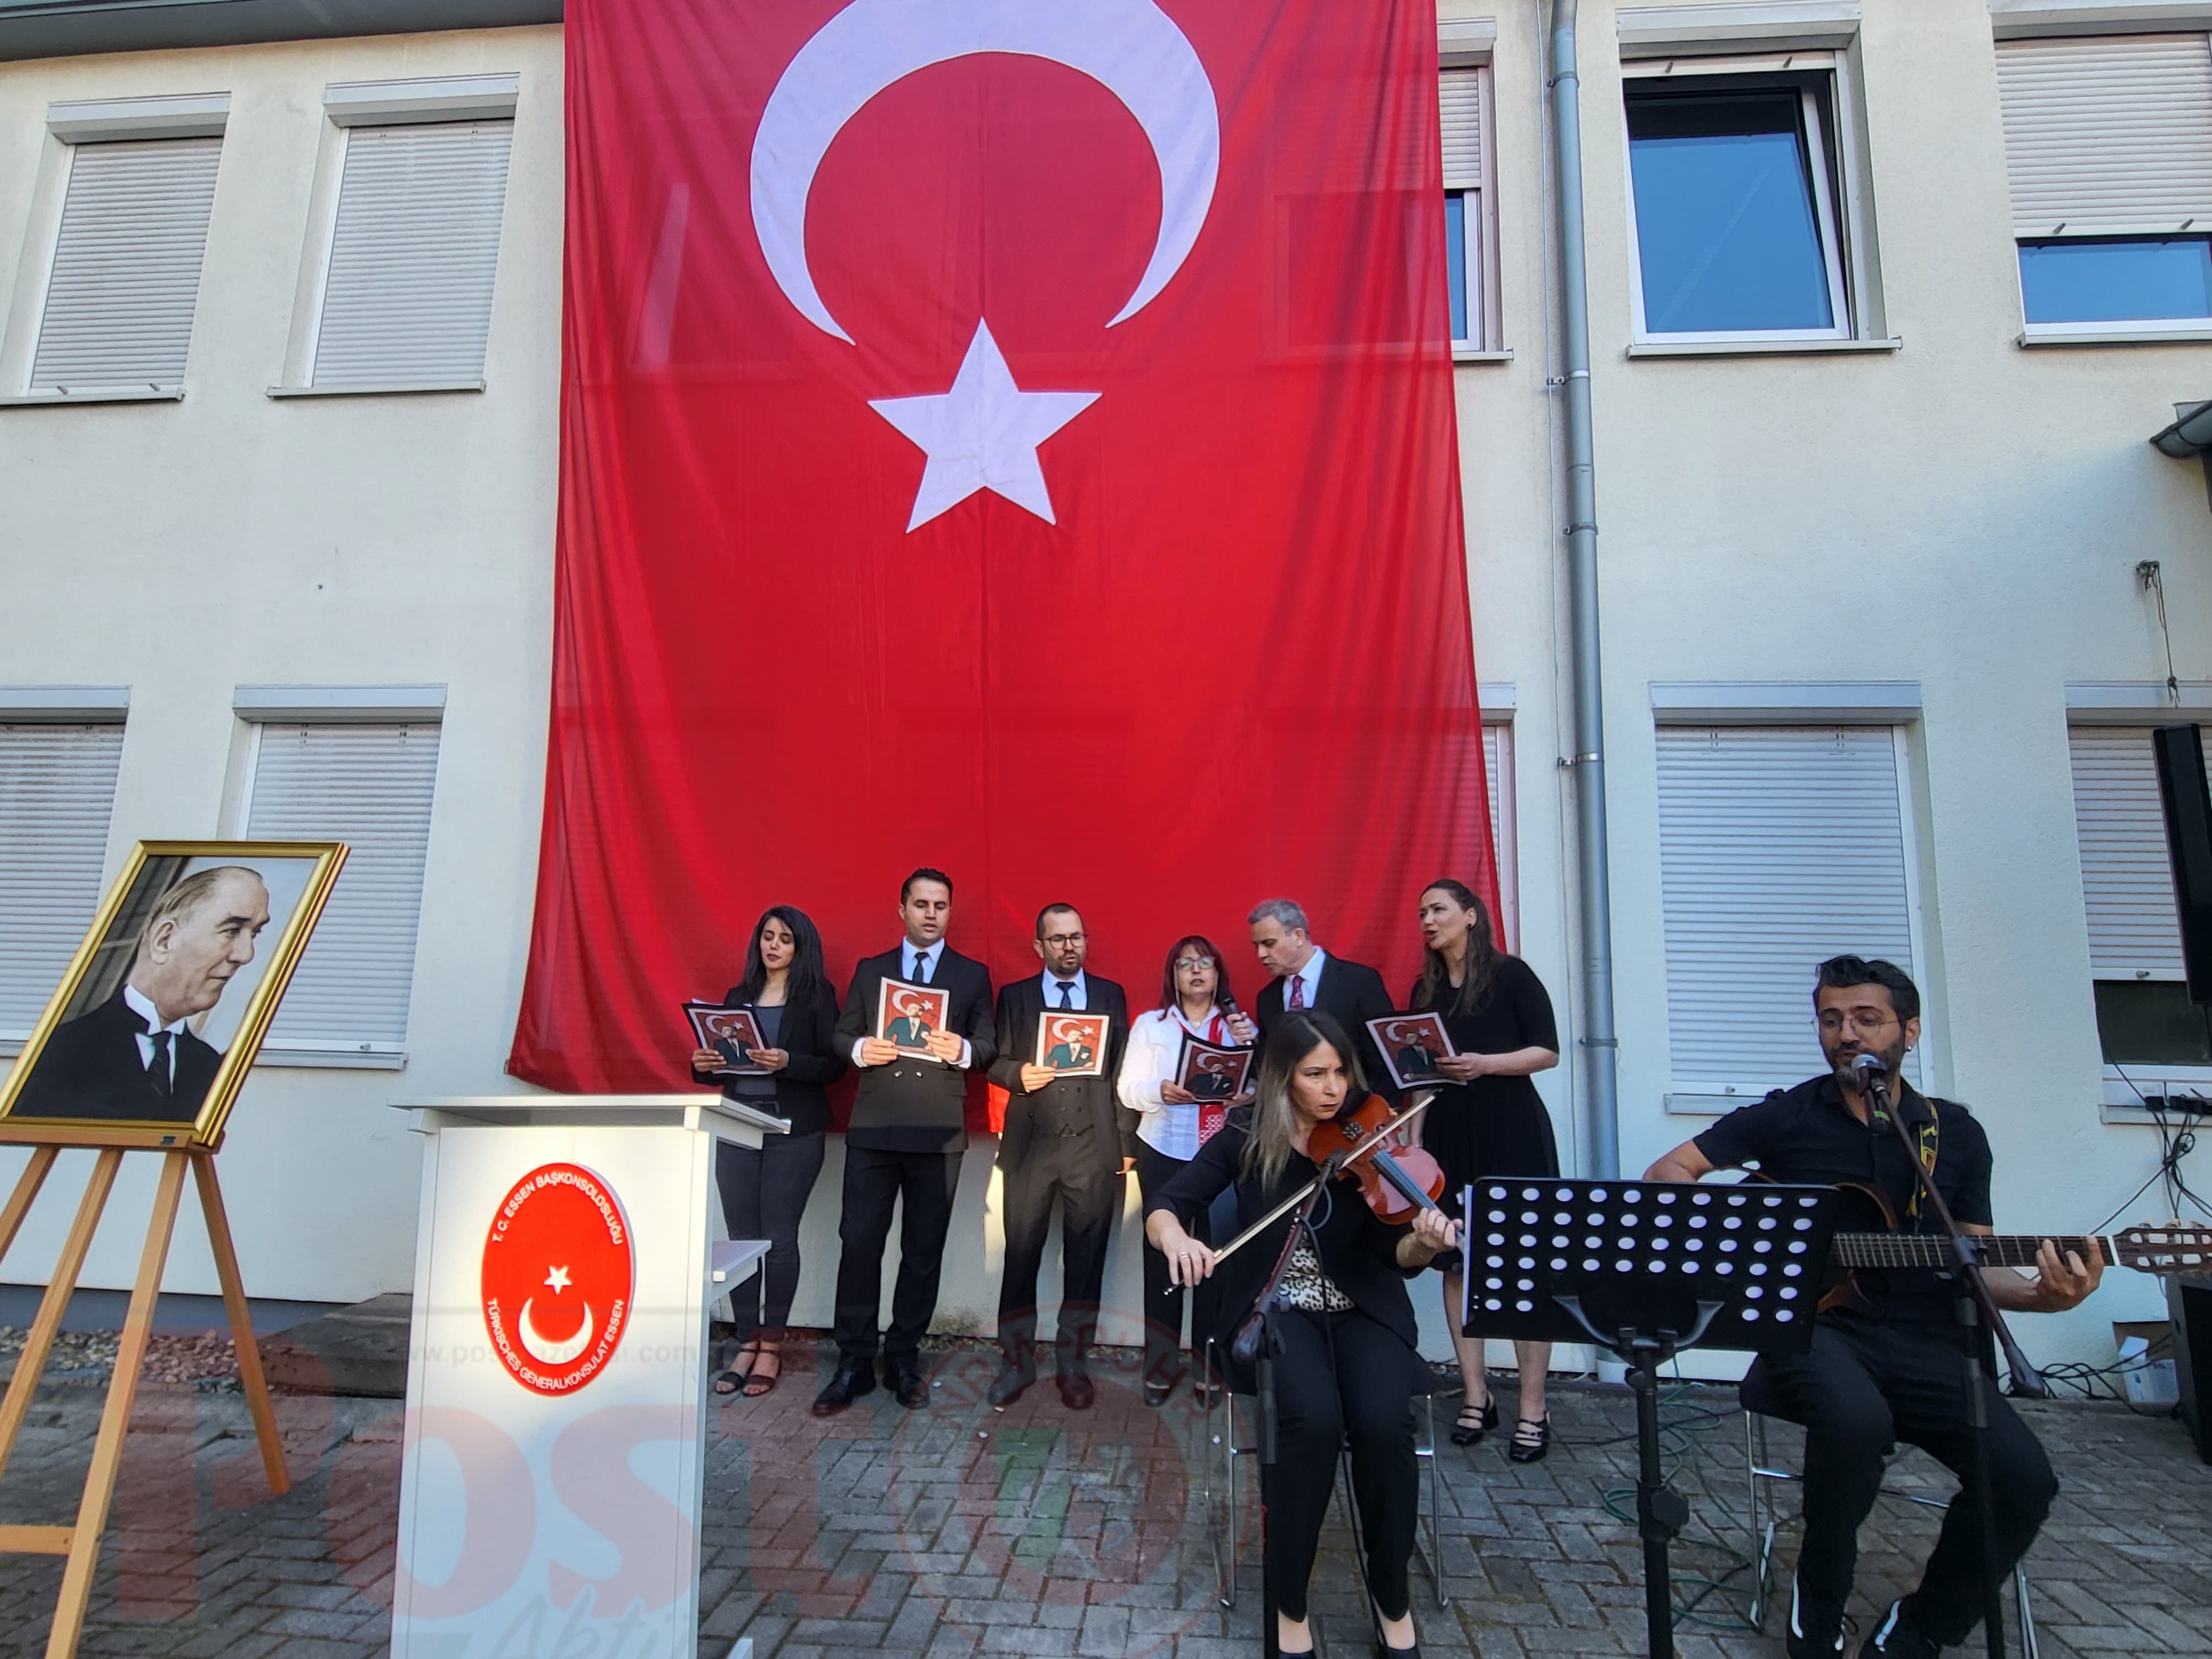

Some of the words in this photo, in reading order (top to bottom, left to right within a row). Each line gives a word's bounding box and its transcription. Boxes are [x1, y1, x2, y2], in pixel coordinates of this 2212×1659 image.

[504, 1181, 536, 1218] ESSEN
[535, 1171, 623, 1245] BAŞKONSOLOSLUĞU
[491, 1232, 504, 1243] T.
[497, 1219, 510, 1232] C.
[487, 1297, 522, 1372] TÜRKISCHES
[519, 1340, 609, 1390] GENERALKONSULAT
[603, 1298, 625, 1343] ESSEN
